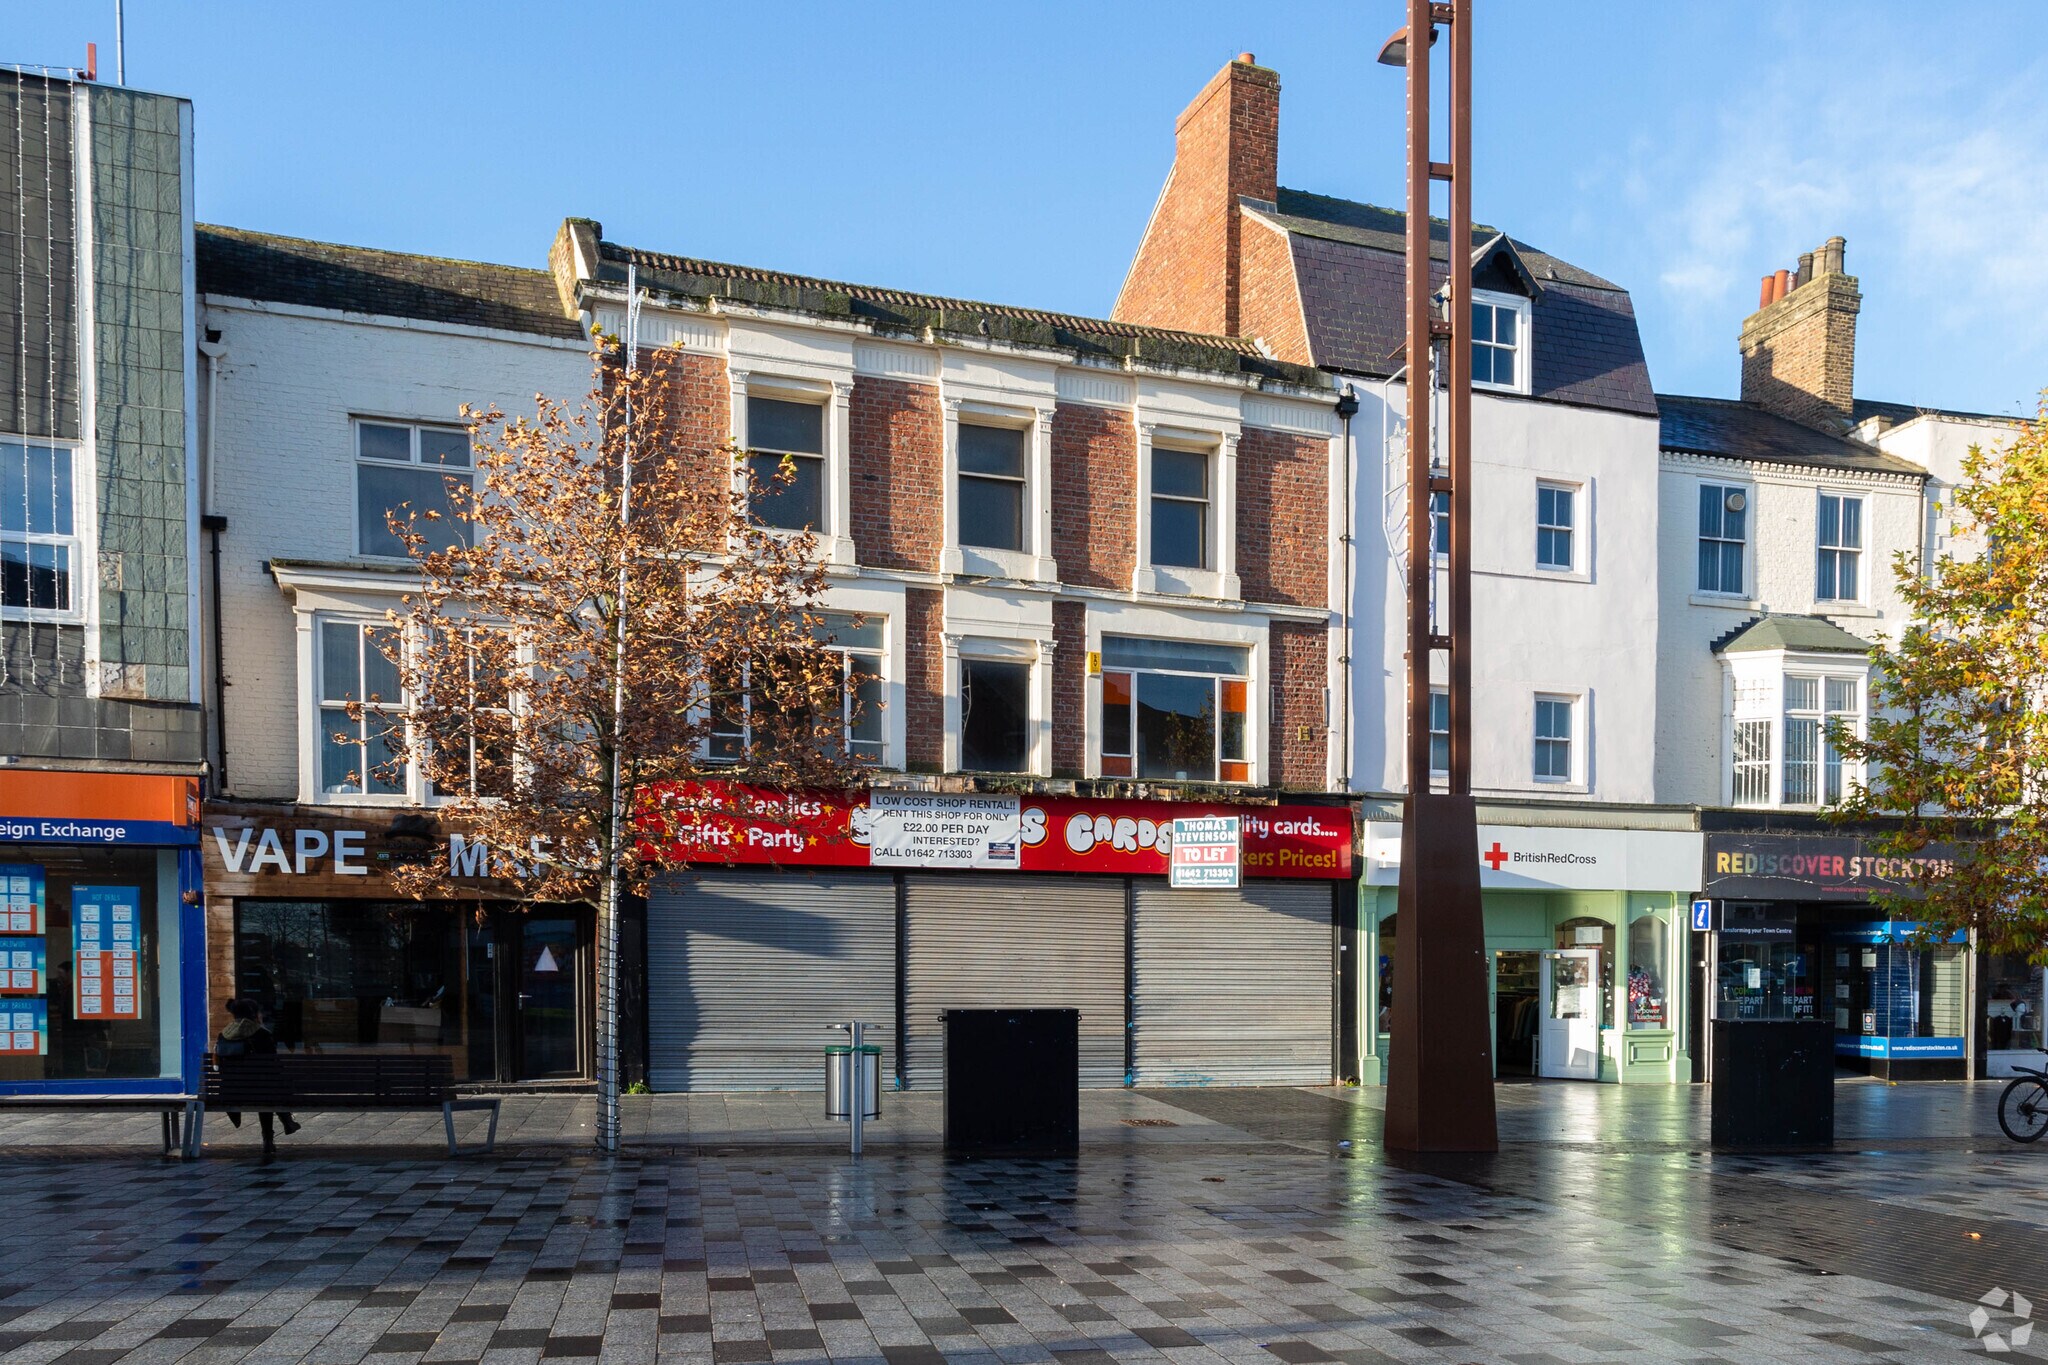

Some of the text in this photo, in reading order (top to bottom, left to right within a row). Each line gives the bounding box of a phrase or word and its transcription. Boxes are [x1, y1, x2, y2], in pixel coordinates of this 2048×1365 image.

[876, 796, 1016, 810] LOW COST SHOP RENTAL!!
[883, 810, 1010, 822] RENT THIS SHOP FOR ONLY
[41, 822, 126, 841] Exchange
[903, 823, 990, 835] £22.00 PER DAY
[1183, 820, 1228, 831] THOMAS
[678, 823, 805, 852] Gifts Party
[1066, 813, 1172, 854] CARDS
[1175, 831, 1237, 842] STEVENSON
[913, 836, 980, 847] INTERESTED?
[212, 826, 368, 875] VAPE
[875, 847, 973, 859] CALL 01642 713303
[1183, 848, 1228, 861] TO LET
[1279, 848, 1337, 868] Prices!
[1716, 852, 1954, 878] REDISCOVER STOCKTON
[1176, 868, 1234, 878] 01642 713303
[1744, 996, 1765, 1005] PART
[1783, 996, 1813, 1005] BE PART
[1793, 1005, 1813, 1014] OF IT!
